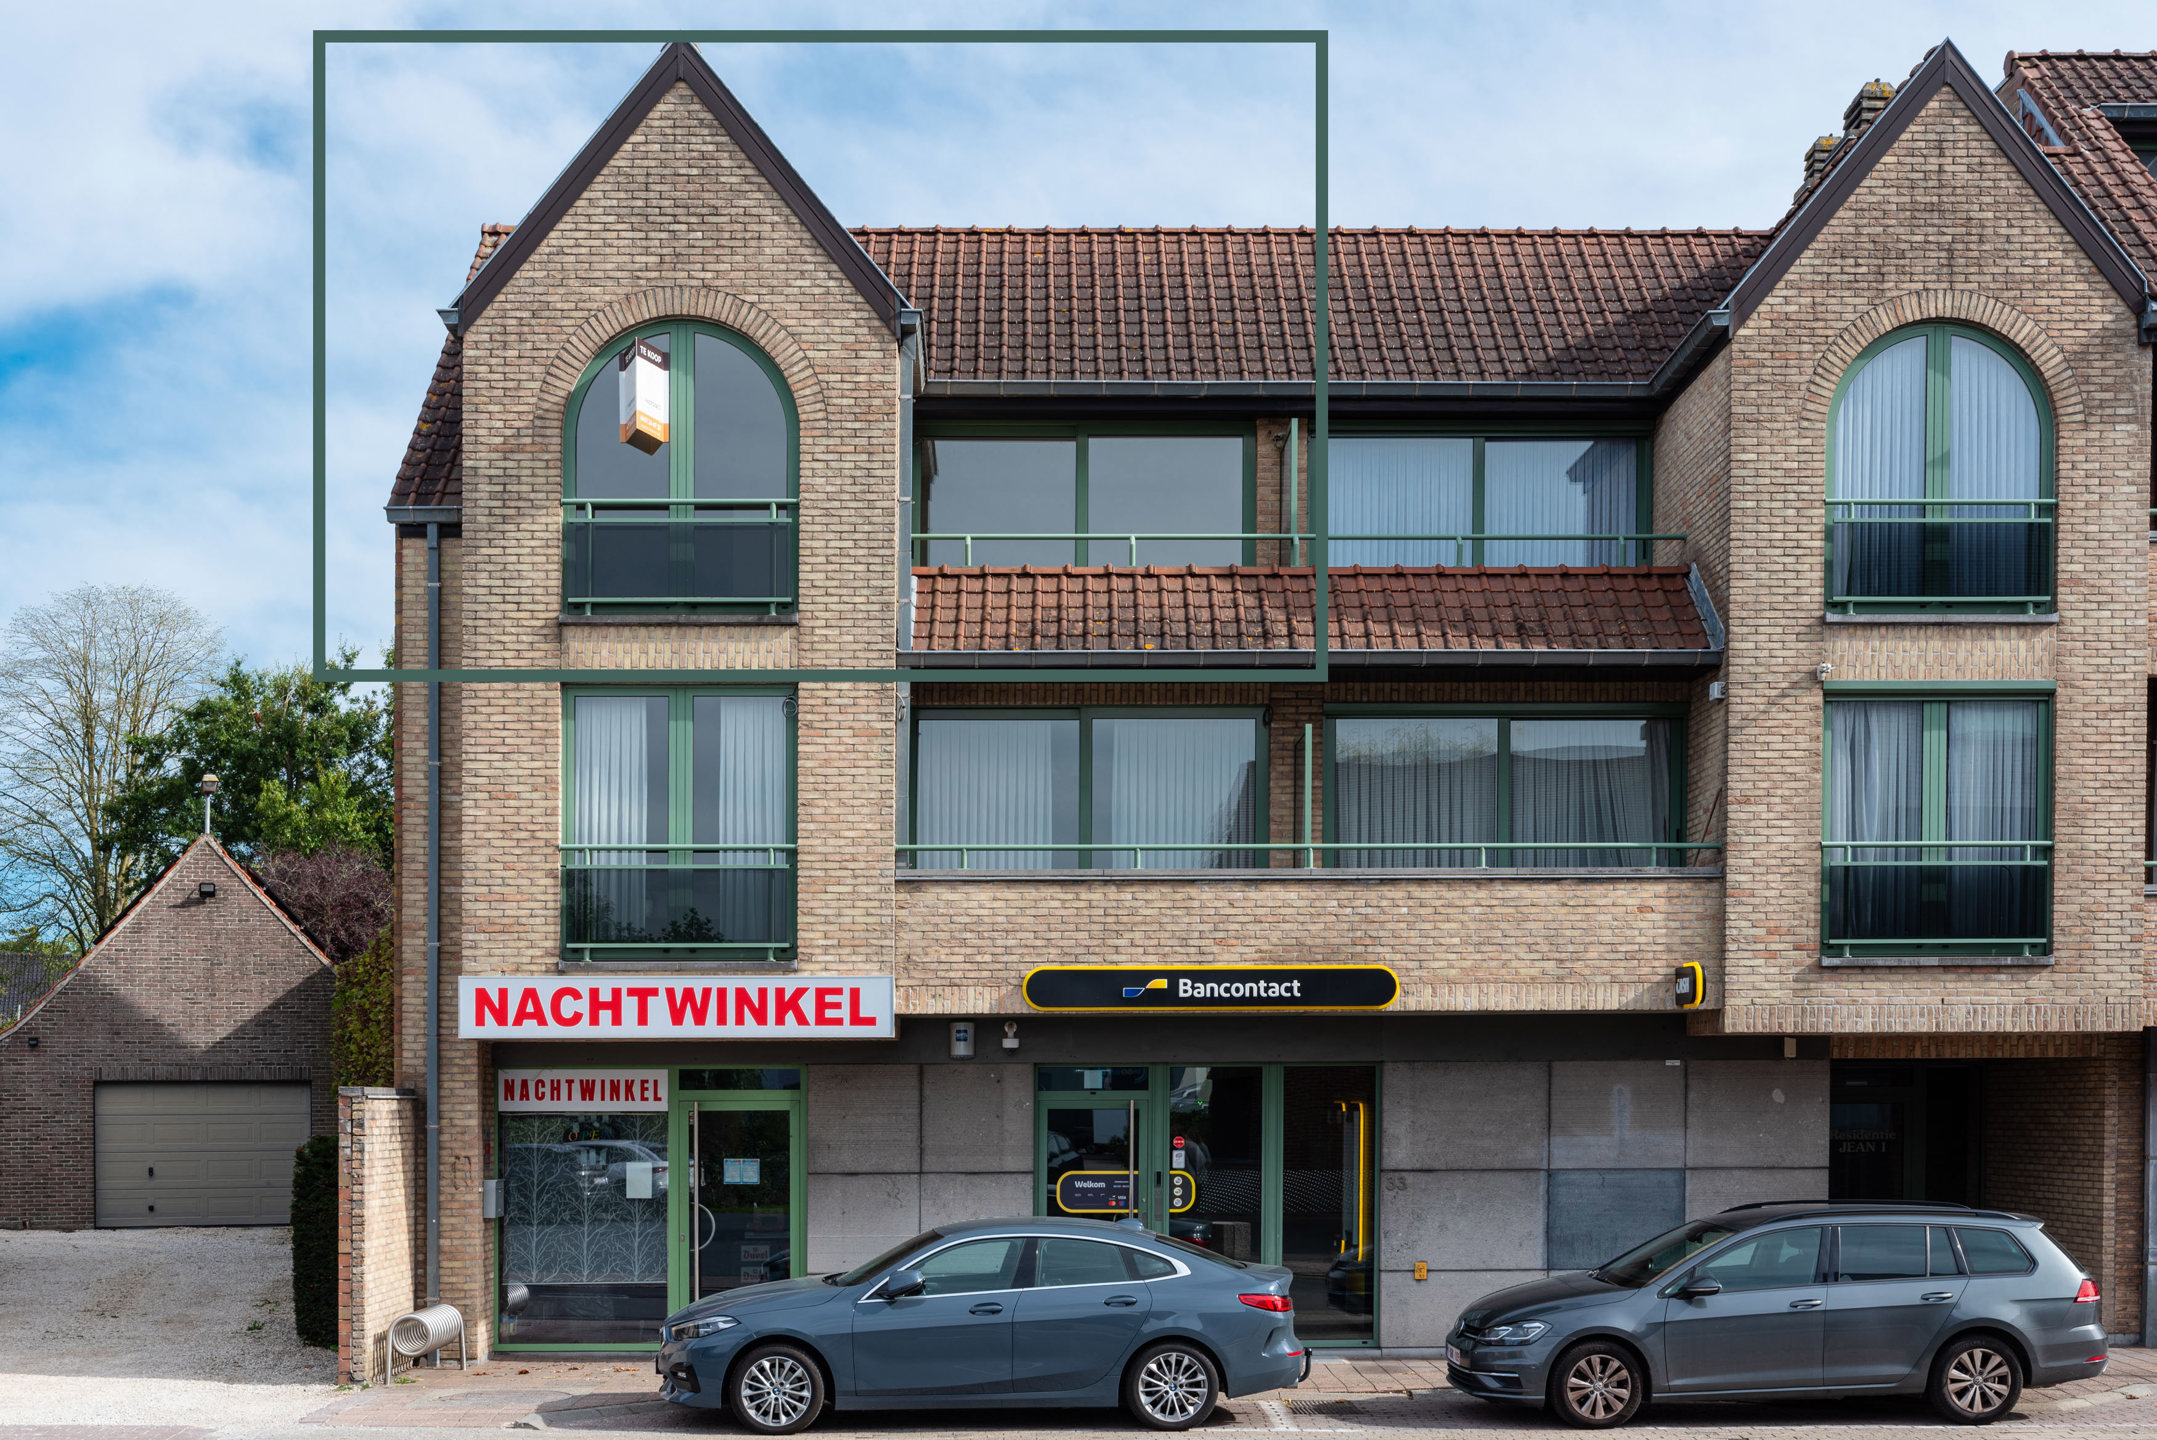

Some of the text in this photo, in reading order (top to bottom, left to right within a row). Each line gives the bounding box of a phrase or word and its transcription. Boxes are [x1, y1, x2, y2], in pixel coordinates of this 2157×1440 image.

[639, 345, 662, 364] TE KOOP
[1178, 978, 1301, 998] Bancontact
[474, 986, 877, 1027] NACHTWINKEL
[503, 1078, 662, 1102] NACHTWINKEL
[1830, 1129, 1896, 1140] Residentie
[1839, 1142, 1876, 1153] JEAN
[1074, 1180, 1105, 1188] Welkom
